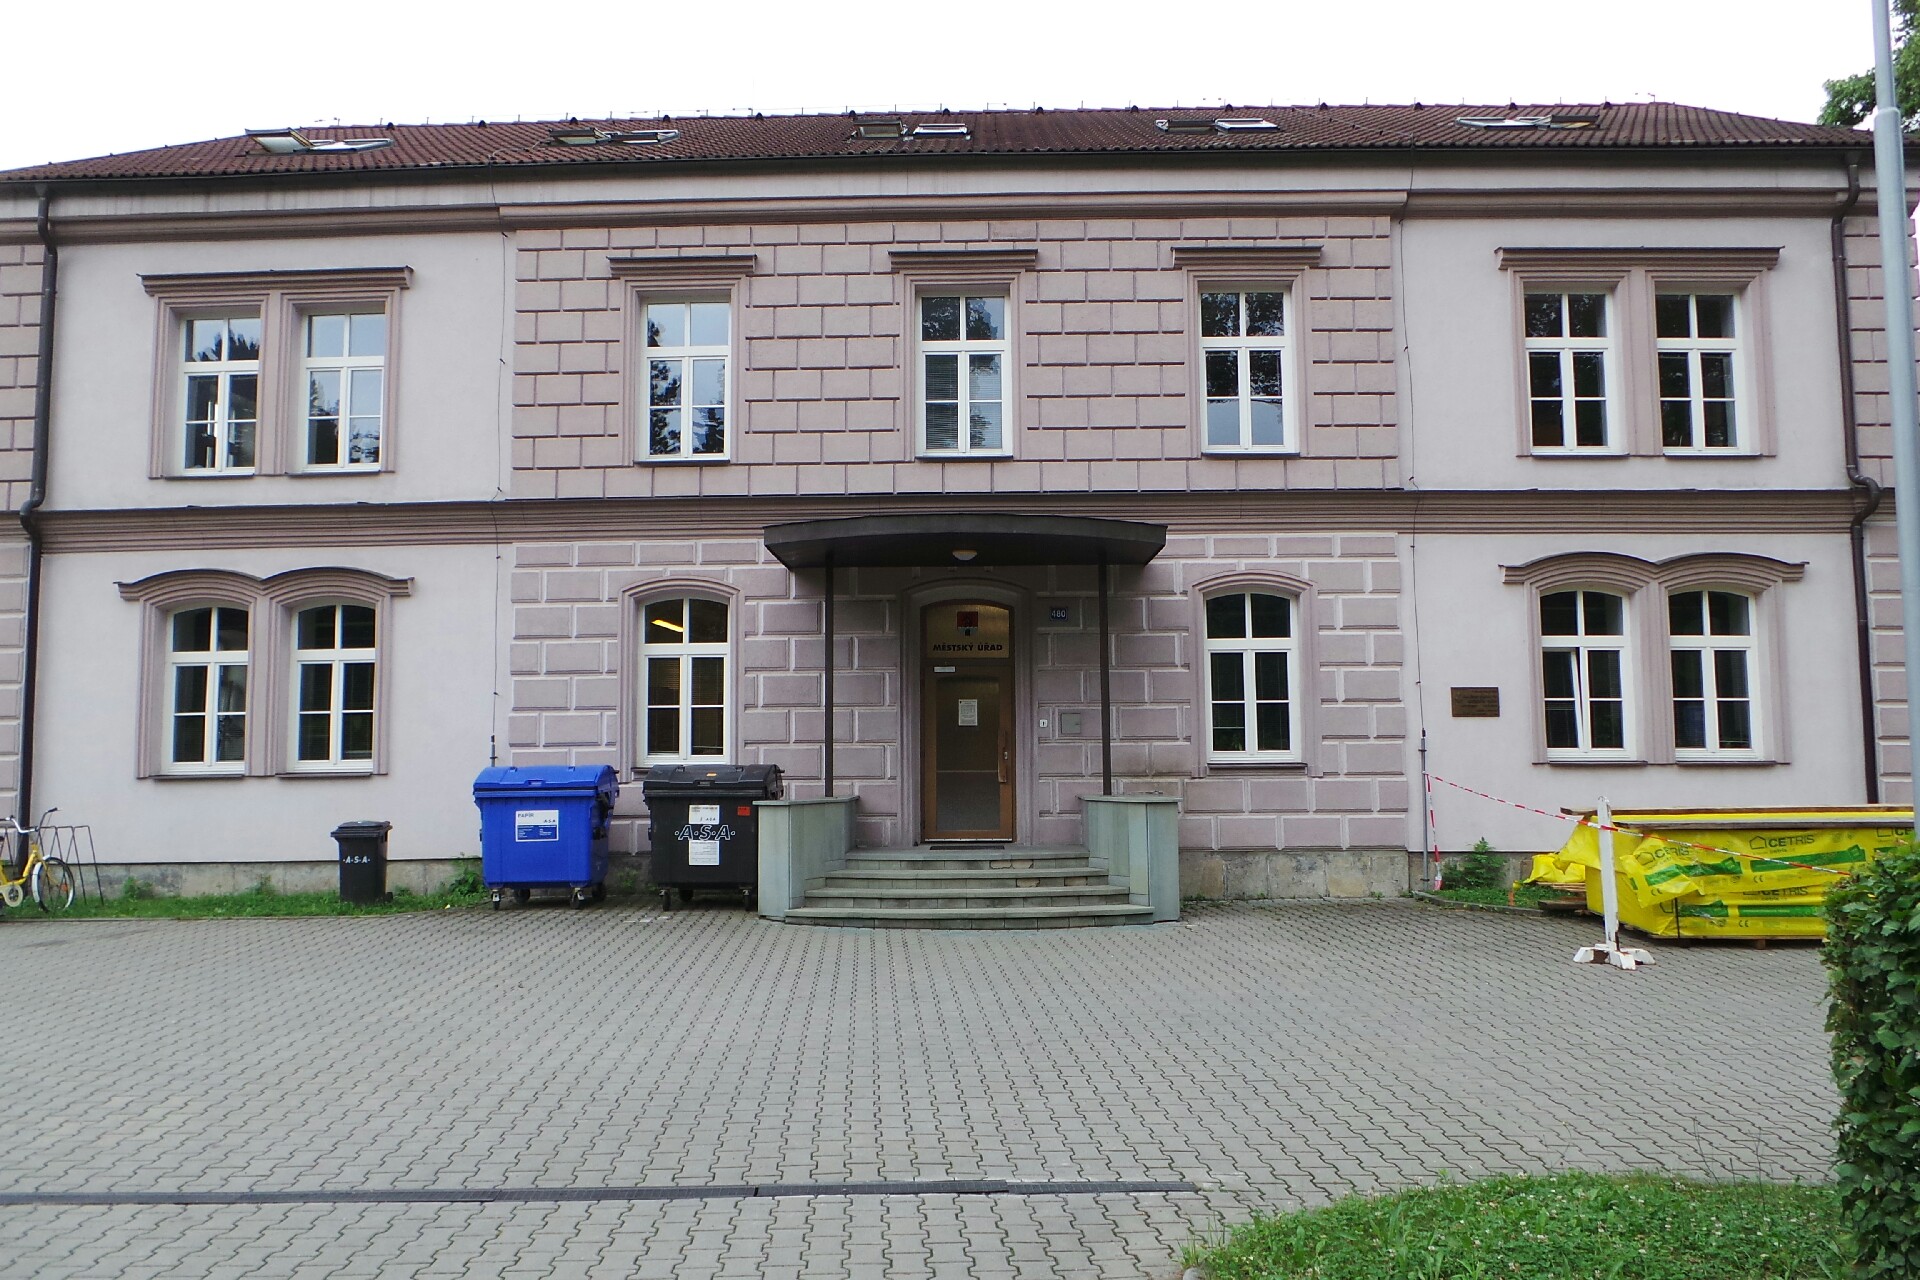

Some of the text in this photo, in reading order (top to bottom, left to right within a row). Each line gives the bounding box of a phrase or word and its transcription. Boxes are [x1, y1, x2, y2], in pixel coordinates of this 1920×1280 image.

[1051, 609, 1066, 618] 480
[932, 641, 1003, 652] MĚSTSKÝ ÚŘAD
[1768, 834, 1815, 848] CETRIS
